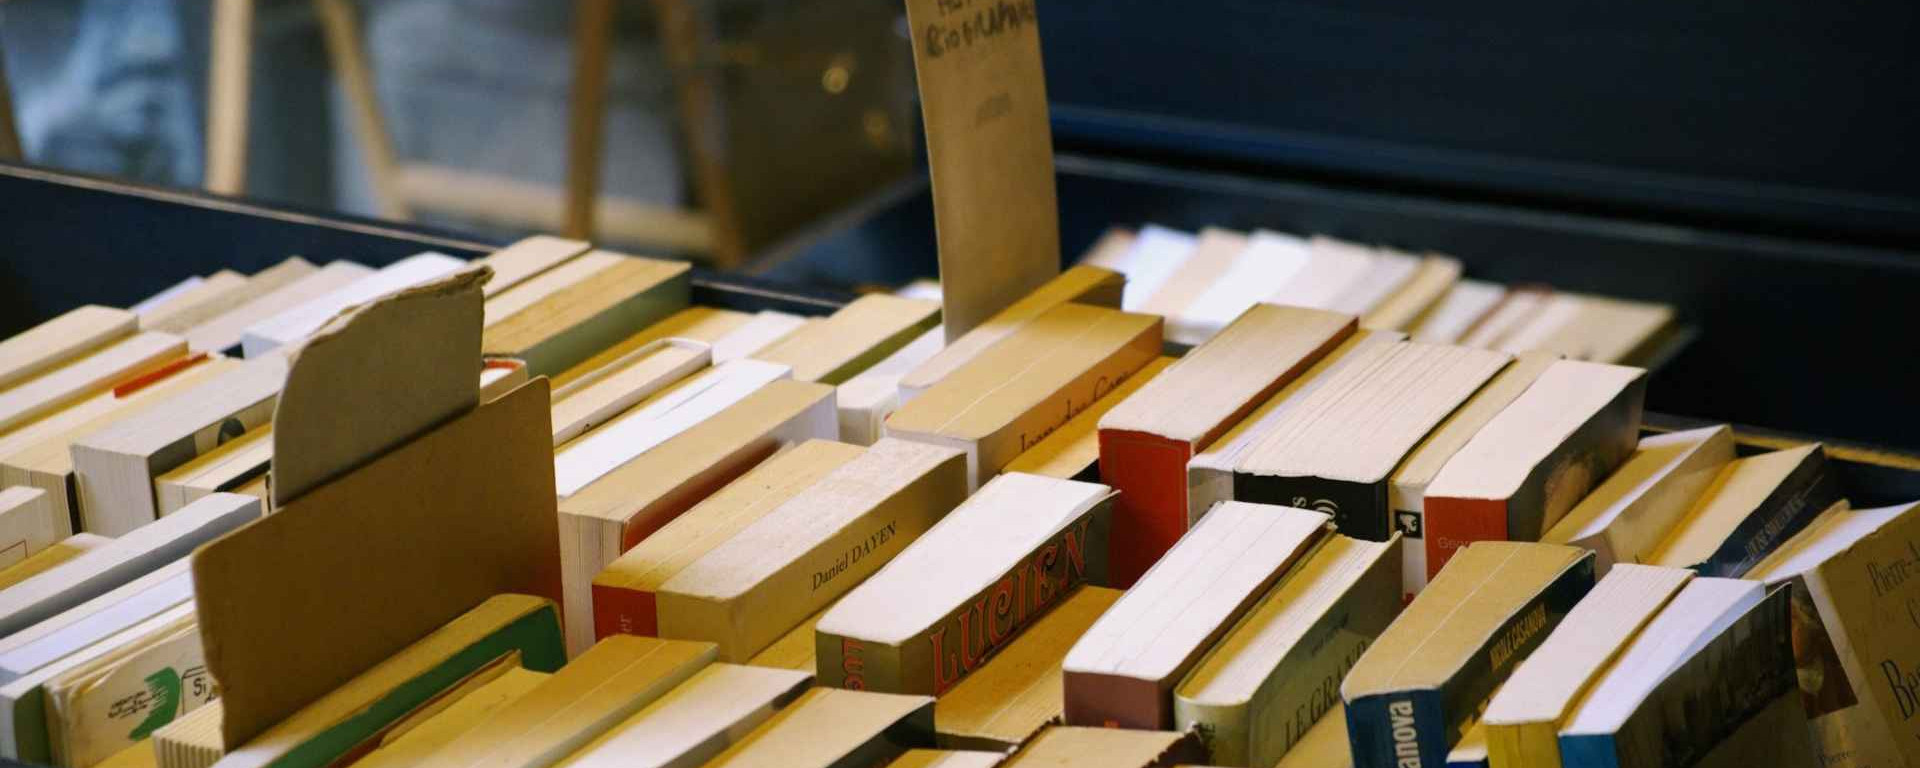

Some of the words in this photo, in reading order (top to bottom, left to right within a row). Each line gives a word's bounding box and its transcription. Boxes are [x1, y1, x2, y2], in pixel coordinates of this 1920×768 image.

[812, 551, 849, 592] Daniel
[852, 521, 897, 564] DAYEN
[930, 513, 1093, 698] LUCIEN
